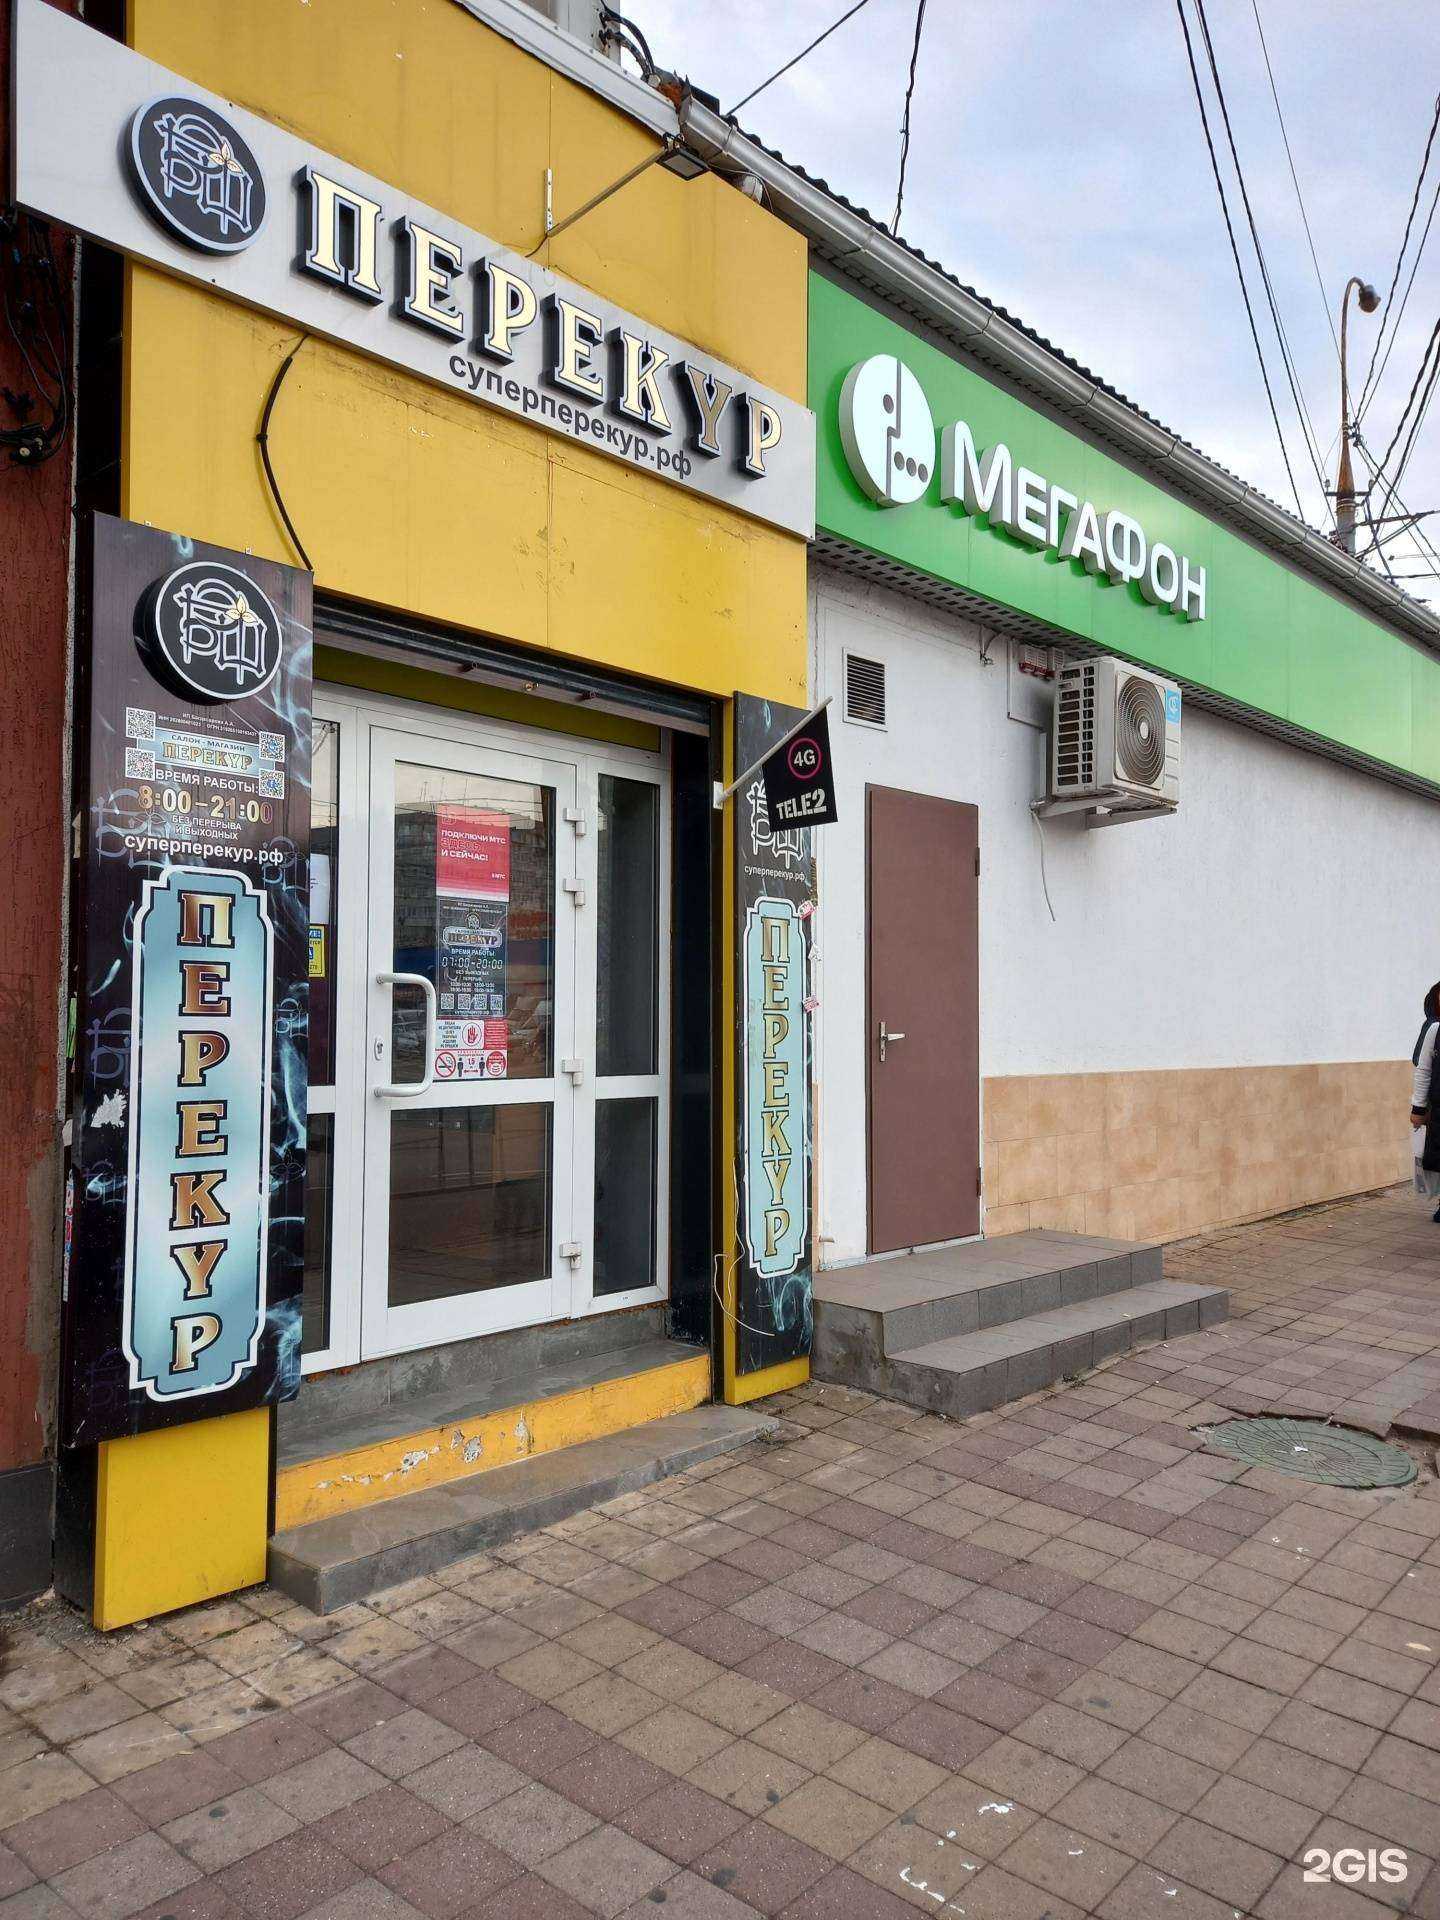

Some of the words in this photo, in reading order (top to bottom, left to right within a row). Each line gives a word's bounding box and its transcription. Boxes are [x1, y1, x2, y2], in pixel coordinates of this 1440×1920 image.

[302, 166, 783, 478] ПЕРЕКУР
[450, 353, 692, 478] суперперекур.рф
[162, 741, 253, 770] ПЕРЕКУР
[171, 734, 201, 744] САЛОН
[207, 740, 245, 752] МАГАЗИН
[793, 749, 815, 767] 4G
[155, 769, 200, 786] ВРЕМЯ
[203, 776, 259, 794] РАБОТЫ:
[776, 788, 827, 820] TELE2
[172, 815, 190, 825] БЕЗ
[192, 817, 242, 831] ПЕРЕРЫВА
[185, 826, 239, 841] ВЫХОДНЫХ
[441, 829, 489, 842] ПОДКЛЮЧИ
[489, 836, 506, 845] МТС
[124, 835, 284, 866] суперперекур.рф
[441, 849, 448, 857] И
[449, 850, 489, 861] СЕЙЧАС!
[744, 865, 806, 882] суперперекур.рф
[760, 916, 792, 1258] ПЕРЕКУР
[170, 890, 235, 1375] ПЕРЕКУР
